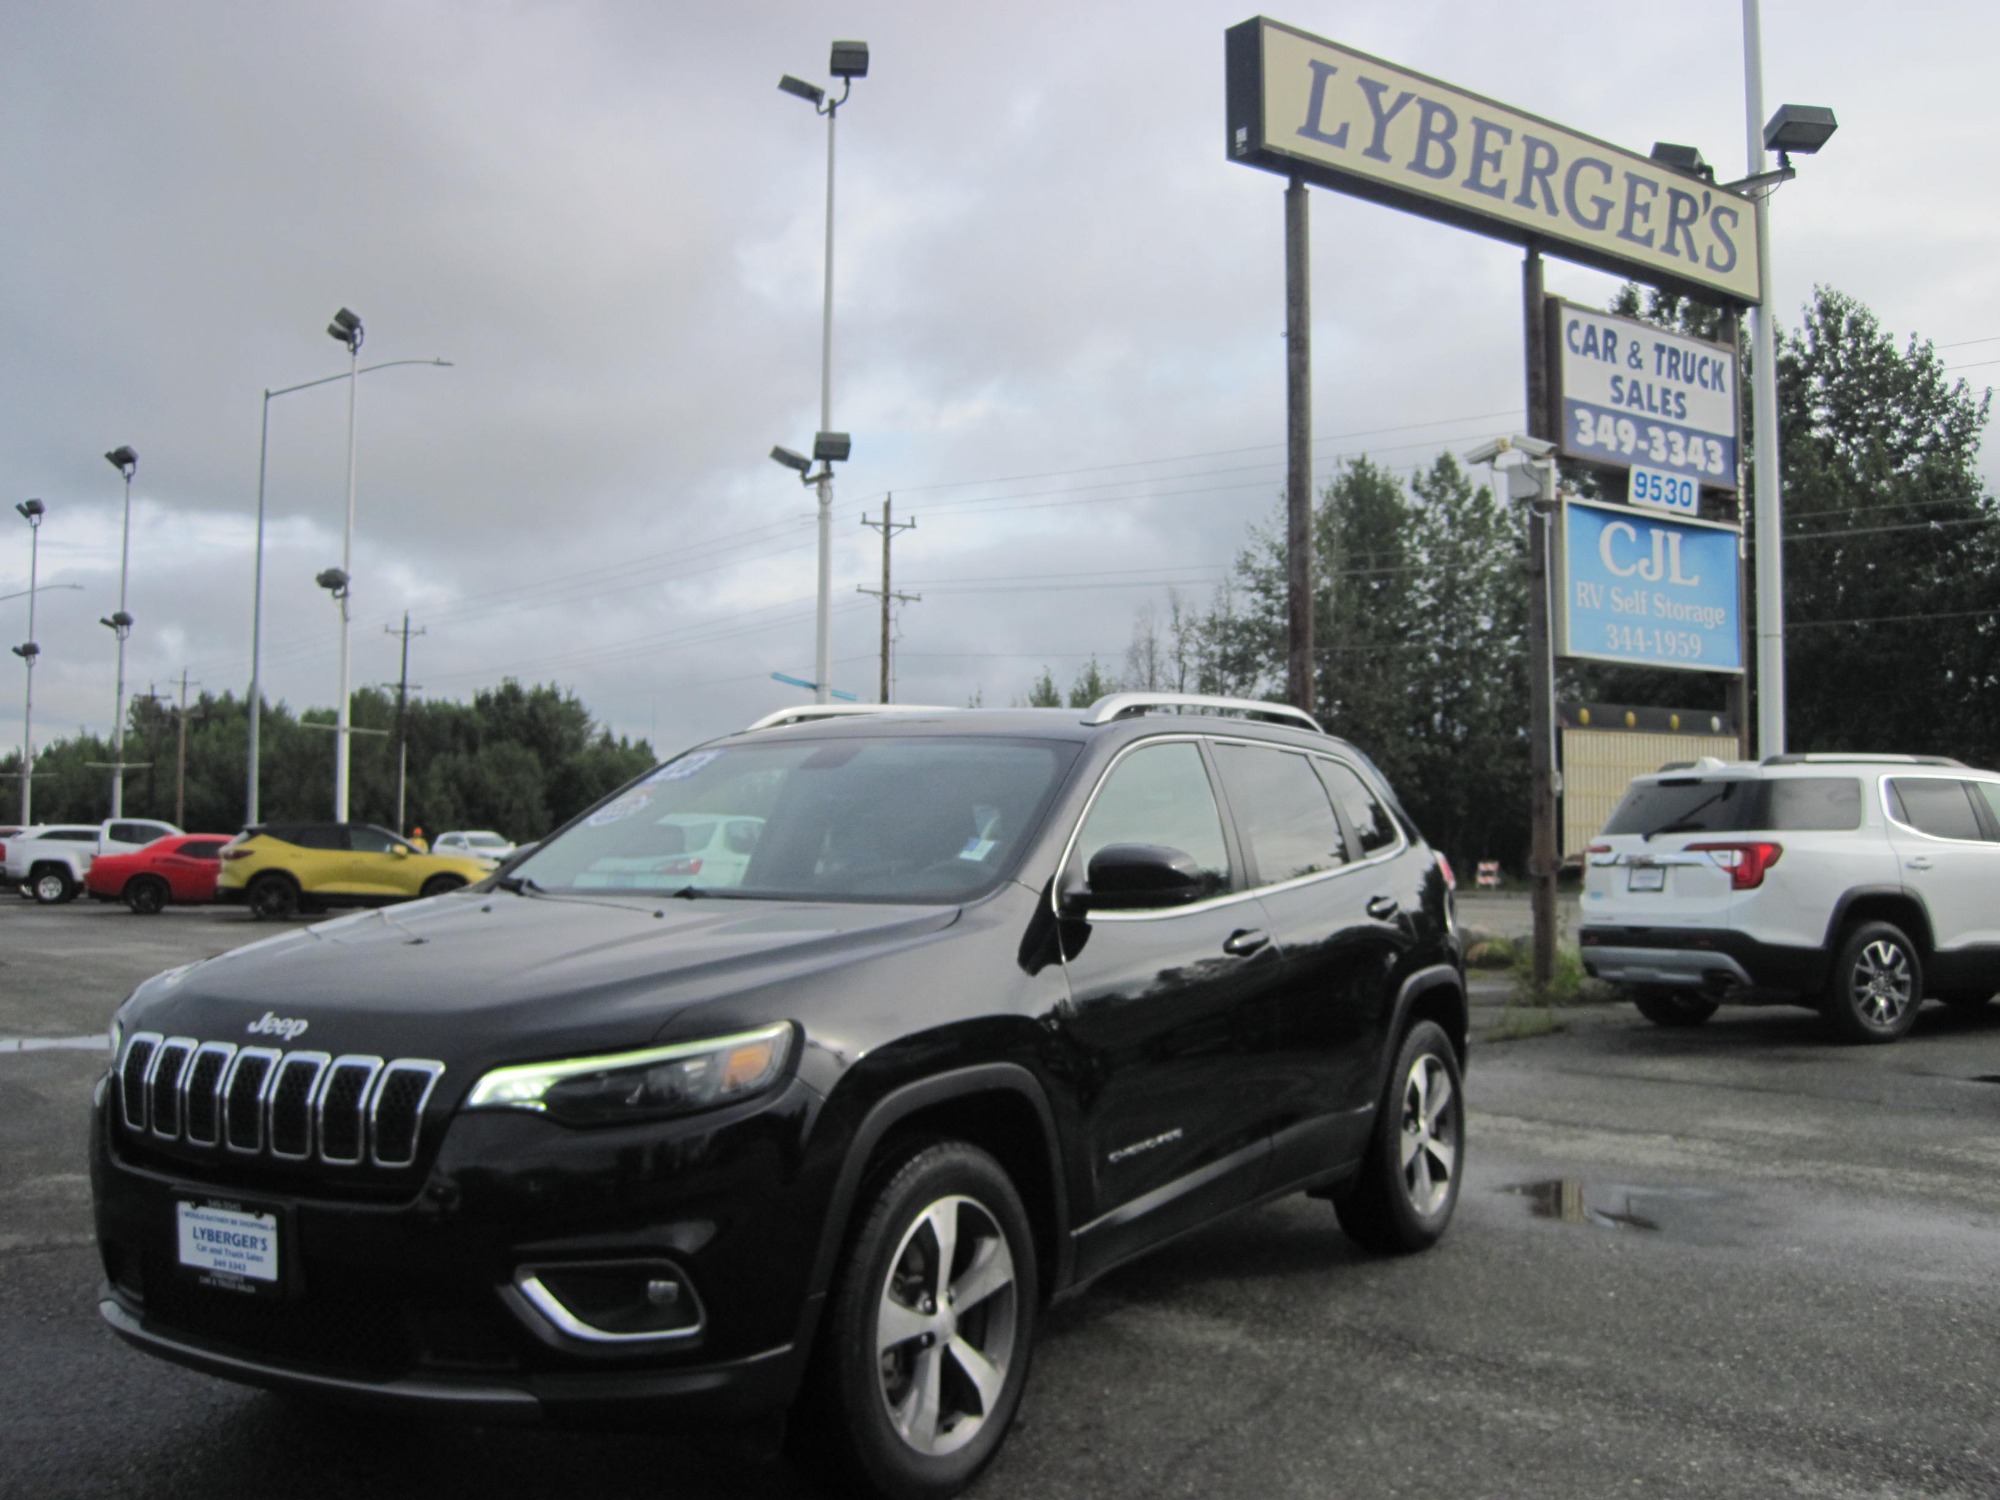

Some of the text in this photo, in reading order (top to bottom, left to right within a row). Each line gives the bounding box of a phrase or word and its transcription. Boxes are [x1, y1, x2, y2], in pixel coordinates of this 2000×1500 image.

[1296, 59, 1739, 274] LYBERGER'S
[1567, 319, 1725, 392] CAR & TRUCK
[1610, 375, 1687, 420] SALES
[1574, 408, 1725, 475] 349-3343
[1634, 472, 1693, 507] 9530
[1599, 520, 1699, 586] CJL
[1576, 581, 1726, 630] RV Self Storage
[1605, 623, 1703, 659] 344-1959
[247, 1011, 309, 1041] Jeep
[193, 1226, 268, 1251] LYBERGER'S
[196, 1243, 207, 1252] Car
